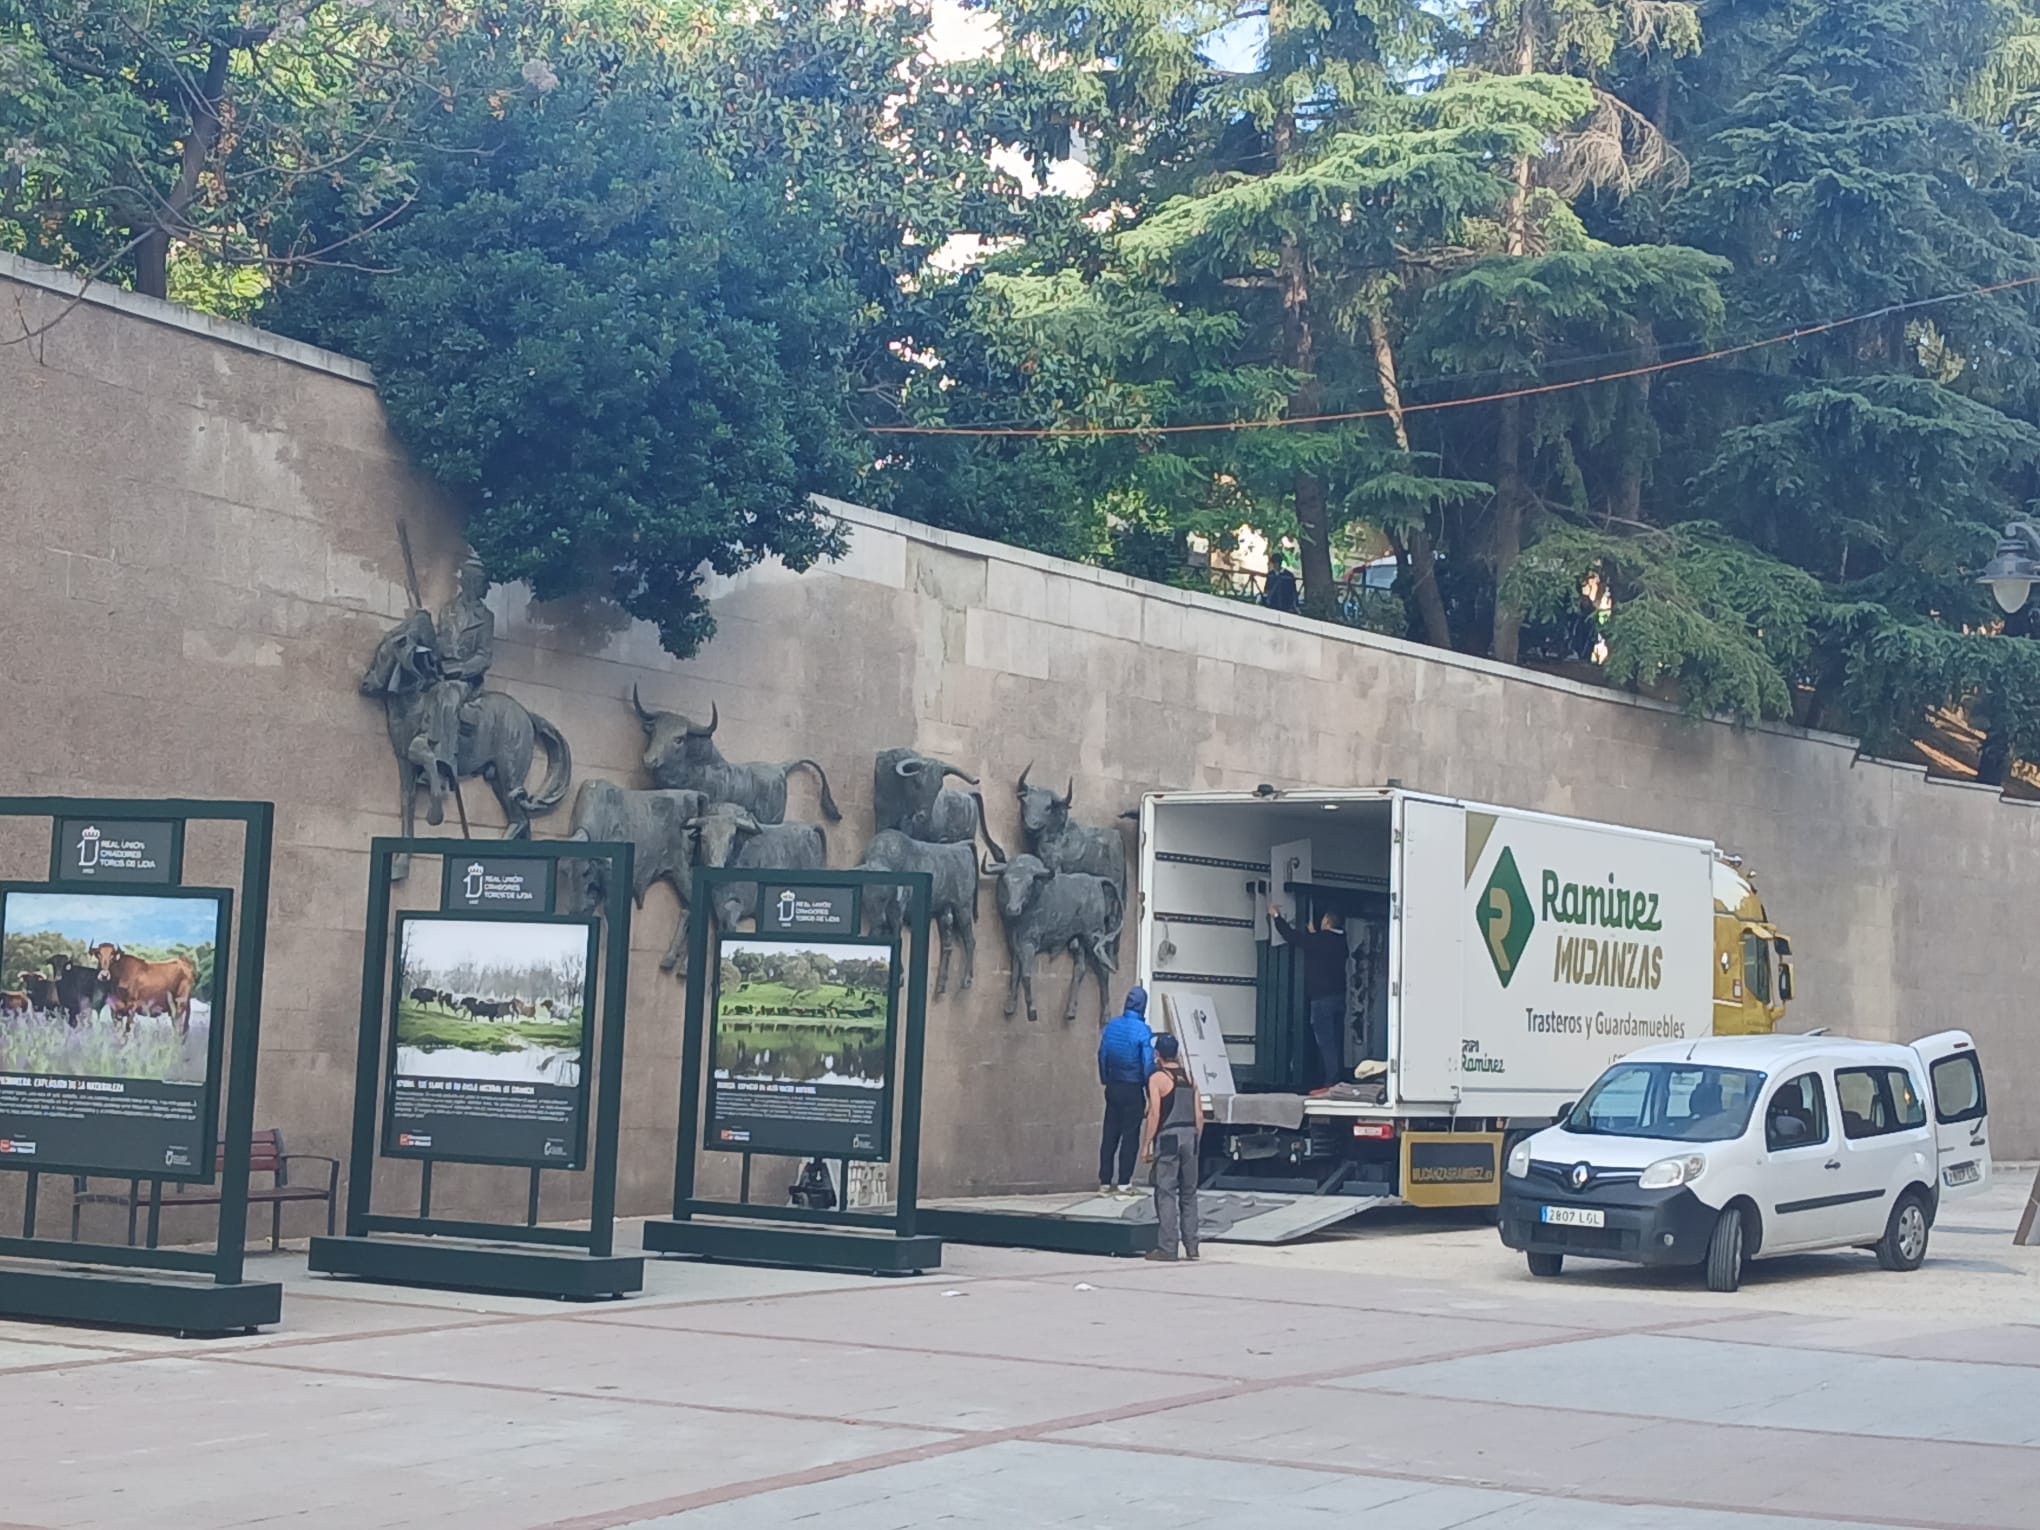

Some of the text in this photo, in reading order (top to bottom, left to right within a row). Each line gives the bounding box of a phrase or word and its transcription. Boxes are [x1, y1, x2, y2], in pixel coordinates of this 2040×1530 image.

[1553, 935, 1663, 990] MUDANZAS
[1525, 1007, 1685, 1040] Trasteros y Guardamuebles
[1549, 1209, 1575, 1222] 2807
